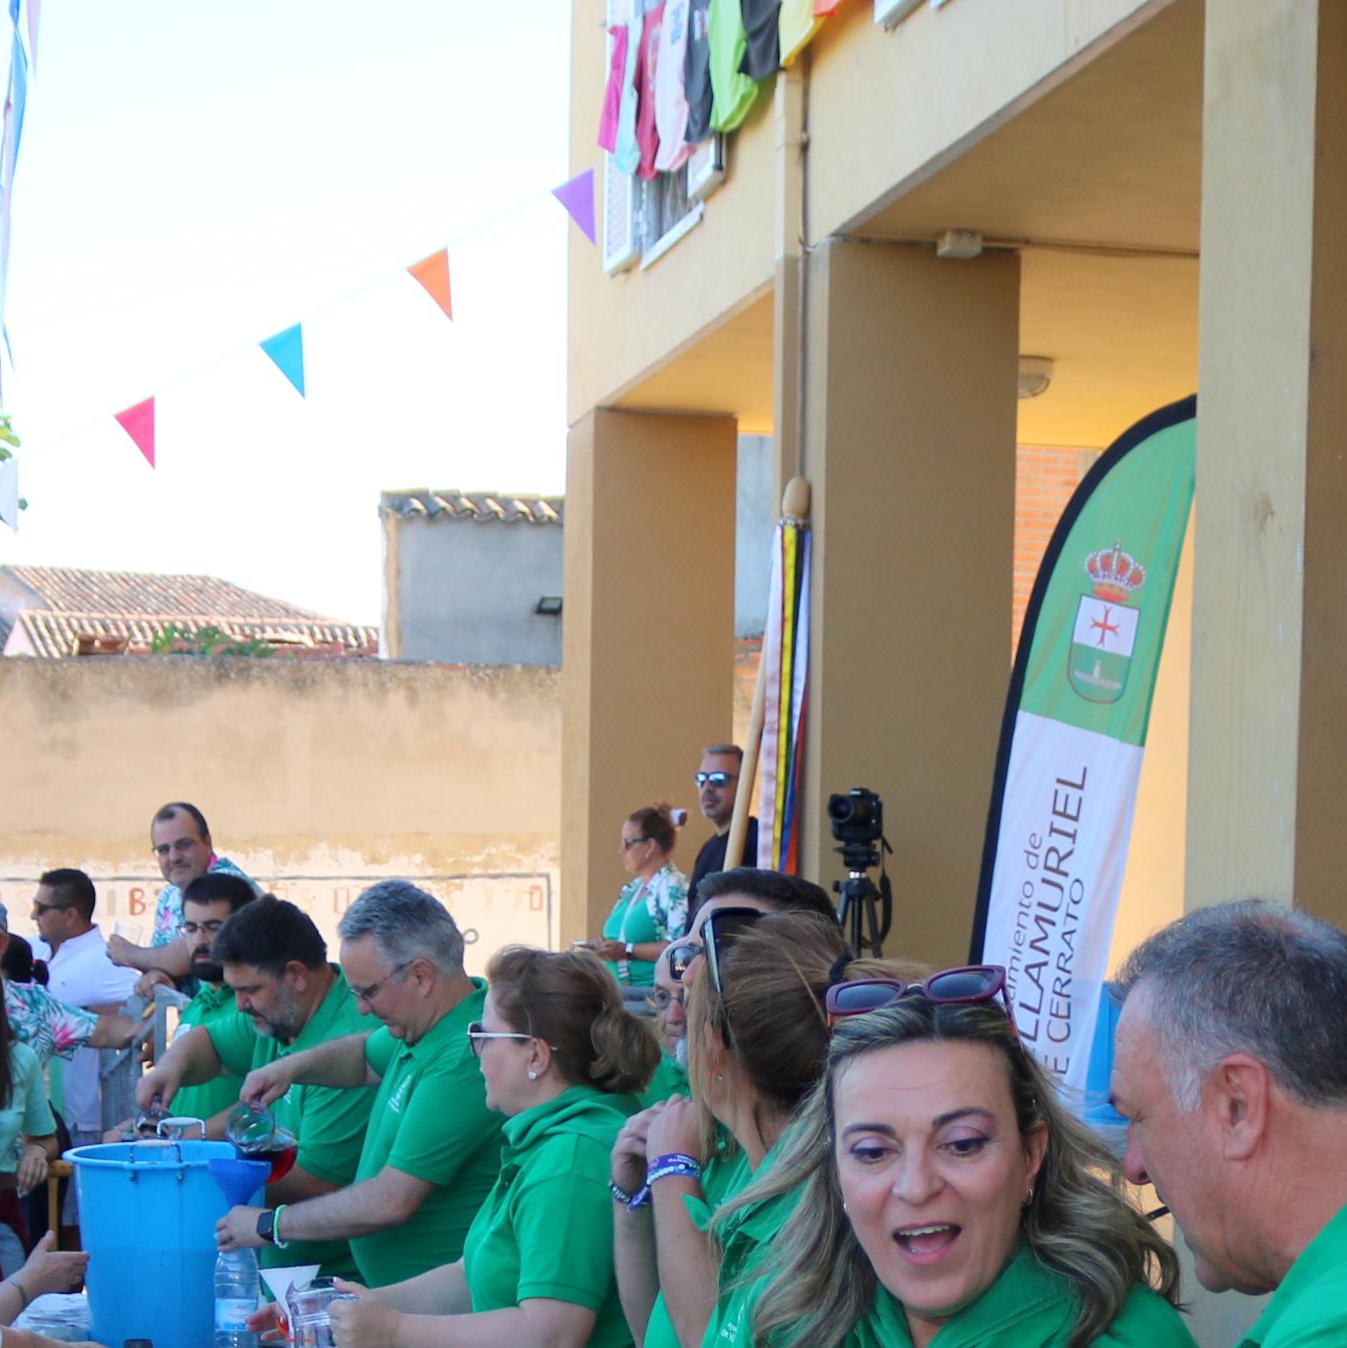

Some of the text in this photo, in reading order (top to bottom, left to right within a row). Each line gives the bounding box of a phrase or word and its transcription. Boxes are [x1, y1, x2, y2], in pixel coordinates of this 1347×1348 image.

[1006, 832, 1043, 1001] amiento de
[1017, 766, 1087, 1044] LLAMURIEL
[1046, 878, 1085, 1045] CERRATO
